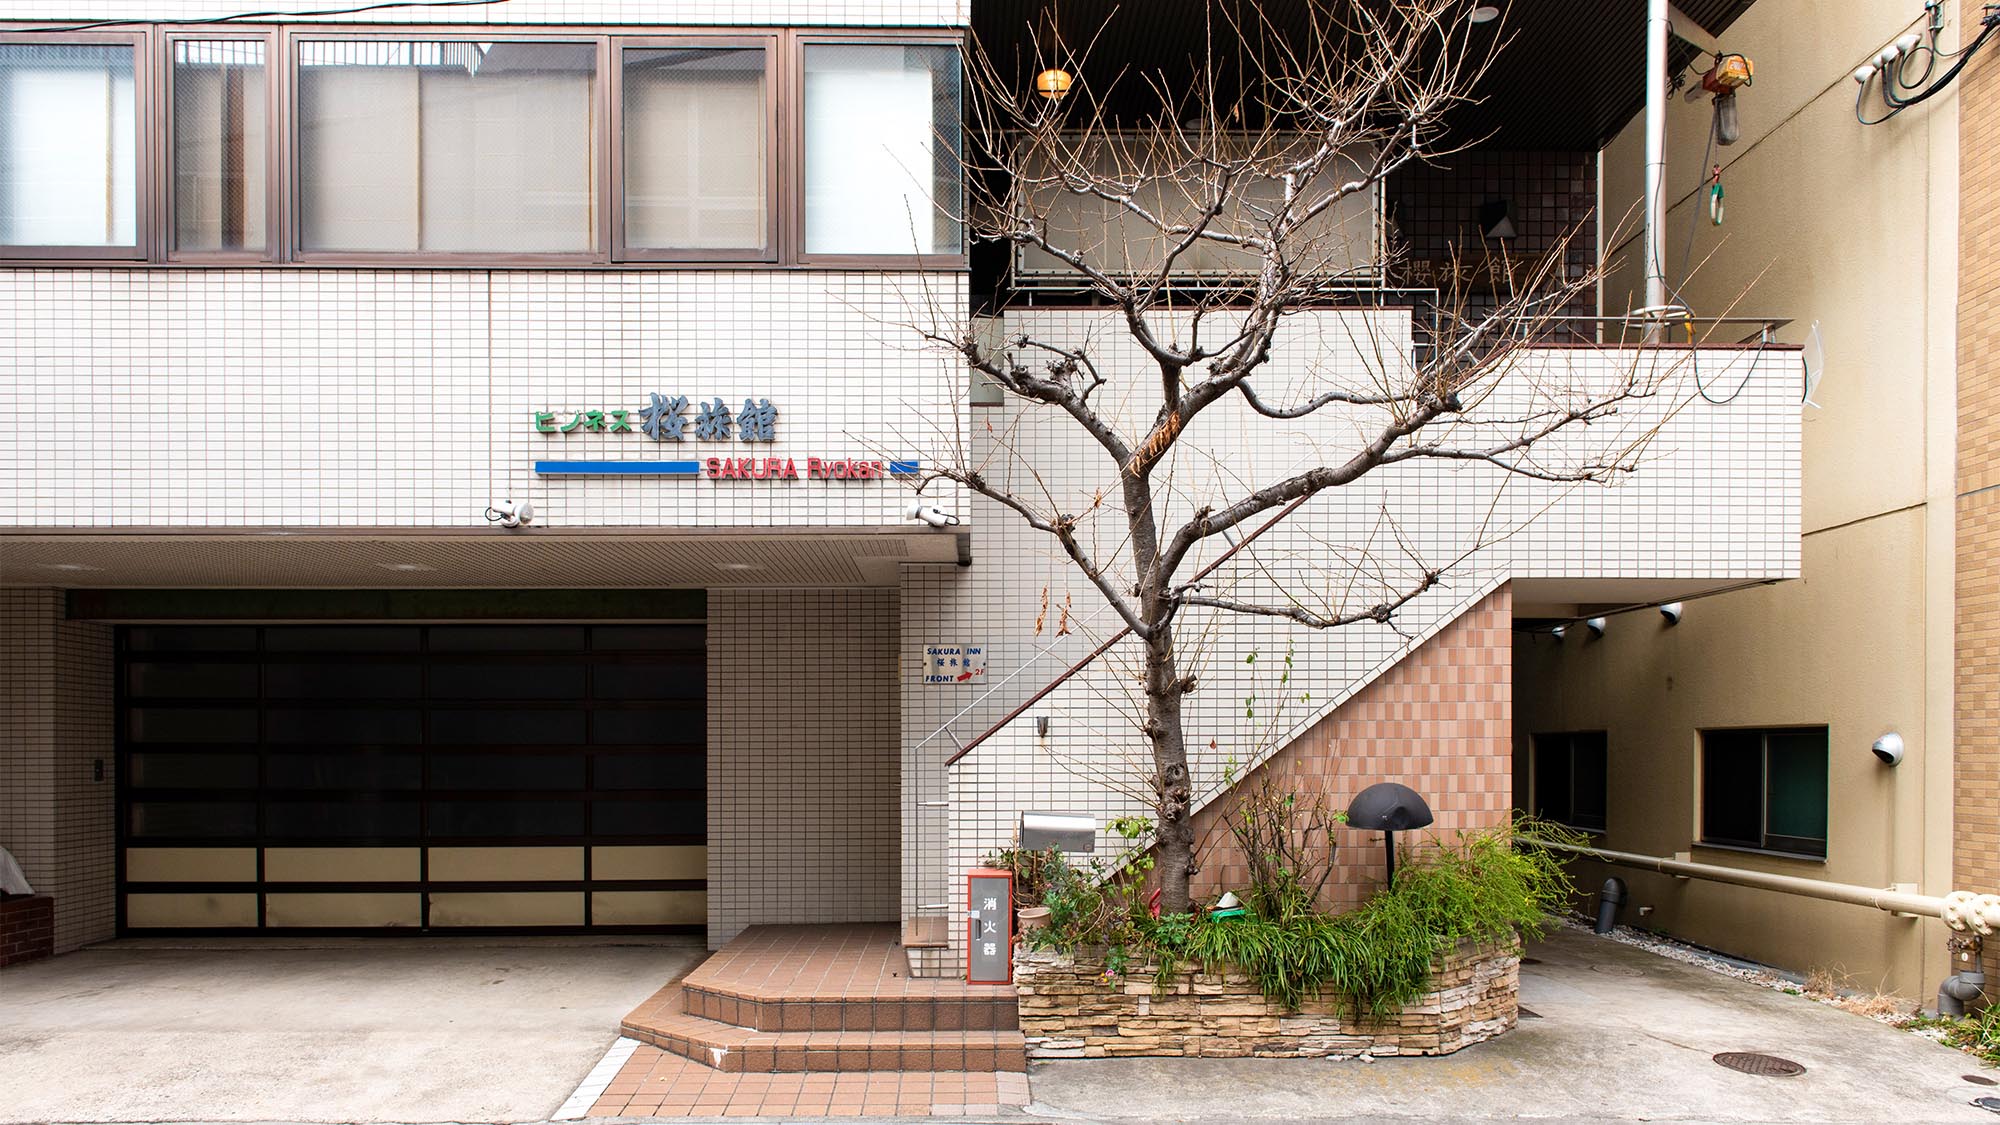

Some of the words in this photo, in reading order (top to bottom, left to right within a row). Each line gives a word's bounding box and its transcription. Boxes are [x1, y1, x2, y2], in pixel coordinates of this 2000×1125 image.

[638, 391, 778, 442] 桜旅館
[706, 456, 799, 480] SAKURA
[807, 456, 883, 480] Ryokan
[926, 647, 961, 656] SAKURA
[966, 647, 982, 655] INN
[925, 675, 954, 683] FRONT
[974, 668, 985, 676] 2F
[983, 897, 997, 956] 消火器
